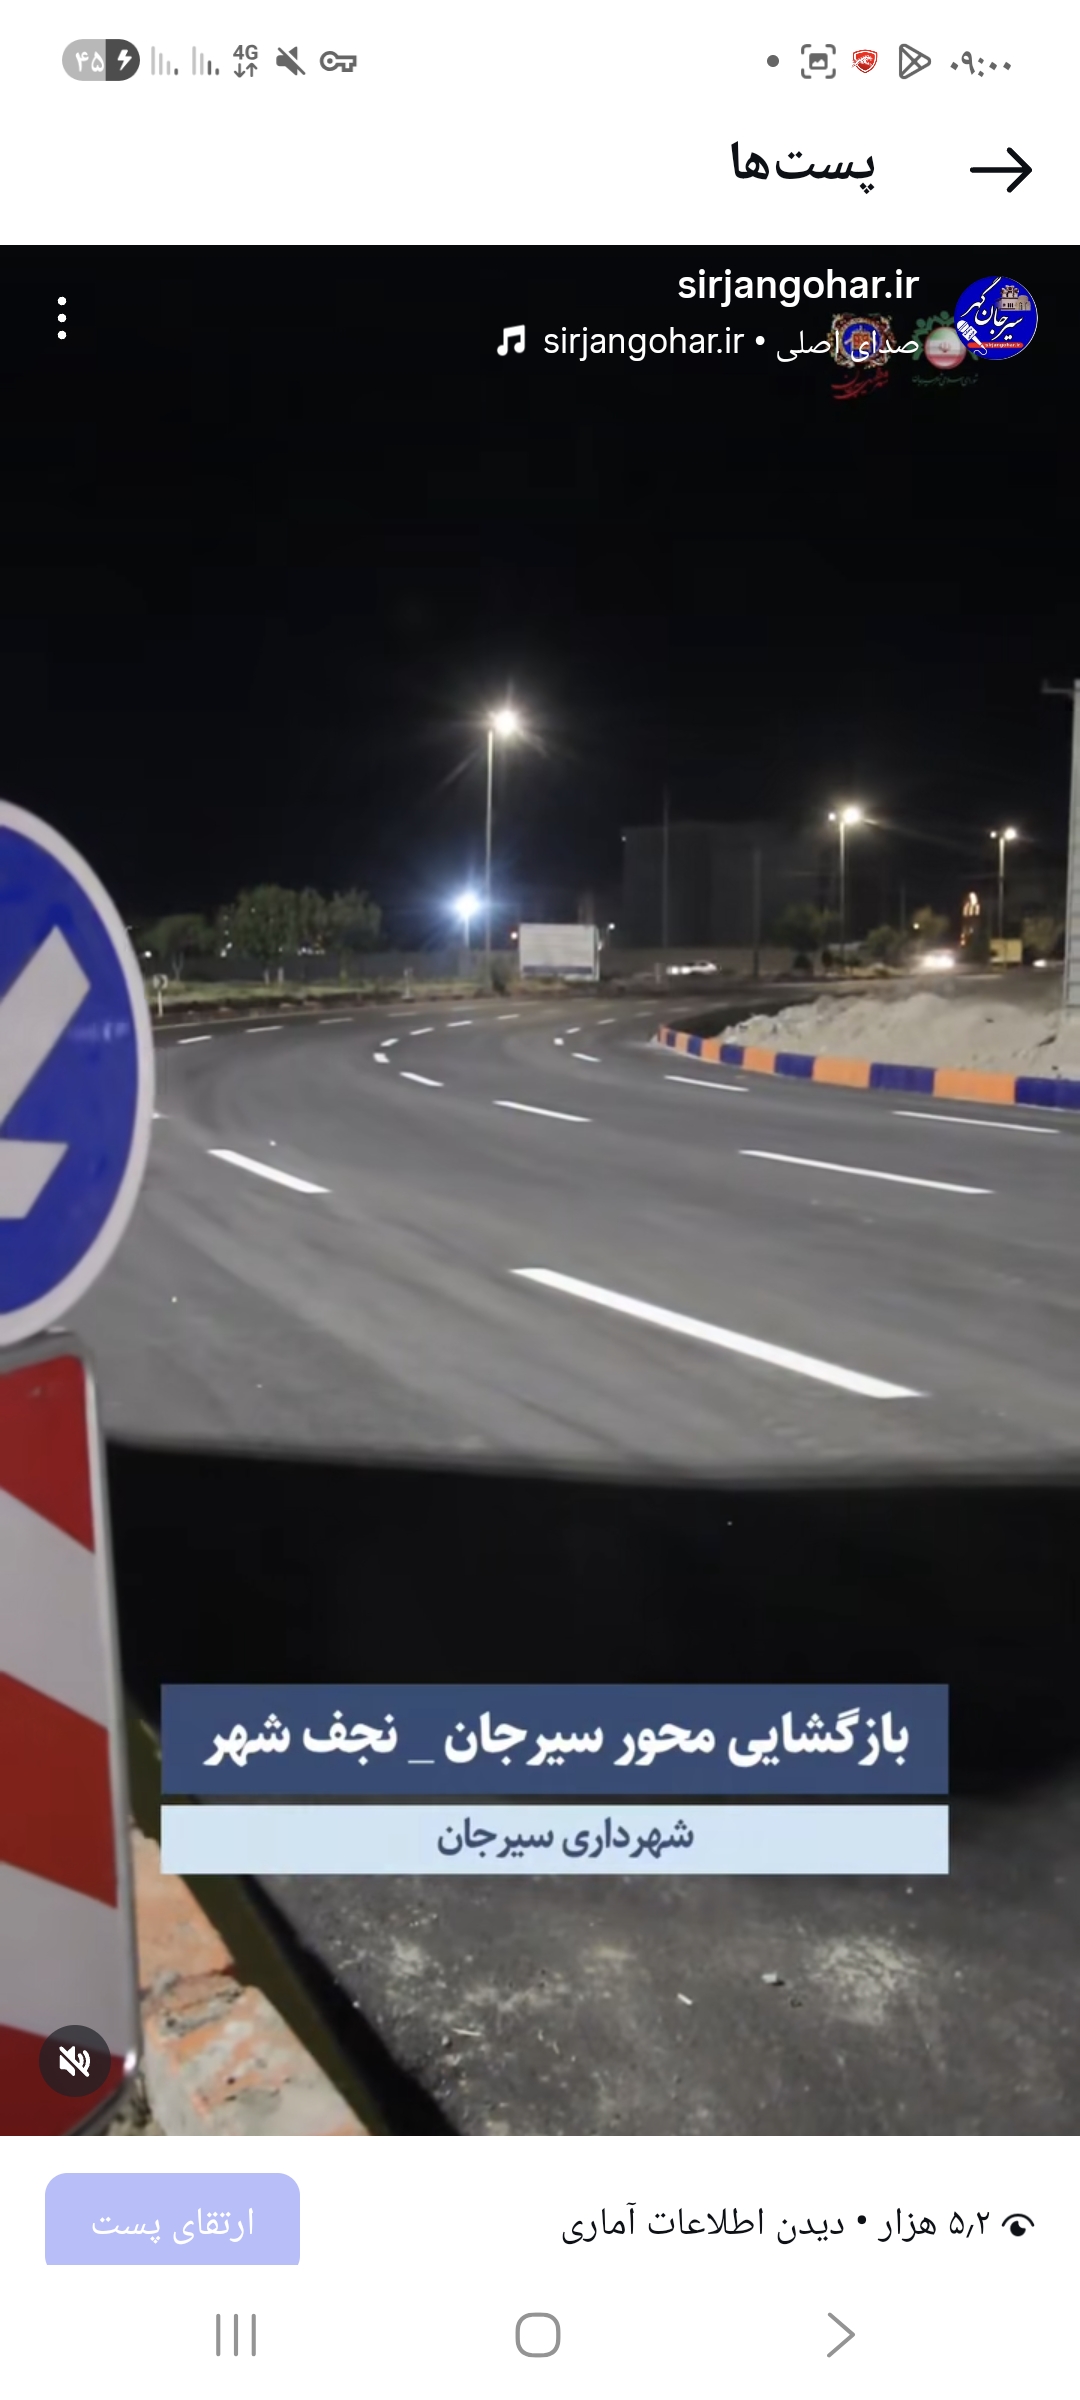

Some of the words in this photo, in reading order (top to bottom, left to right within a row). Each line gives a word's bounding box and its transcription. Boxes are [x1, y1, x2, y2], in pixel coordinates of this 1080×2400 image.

[233, 45, 258, 61] 4G
[678, 268, 920, 308] sirjangohar.ir
[974, 305, 1024, 341] سیرجان
[543, 326, 745, 362] sirjangohar.ir
[777, 330, 839, 363] اصلی
[850, 330, 919, 363] صدای
[91, 2216, 161, 2245] پست
[173, 2207, 254, 2245] ارتقای
[562, 2202, 637, 2245] آماری
[648, 2207, 764, 2235] اطلاعات
[777, 2218, 844, 2245] دیدن
[877, 2207, 937, 2243] هزار
